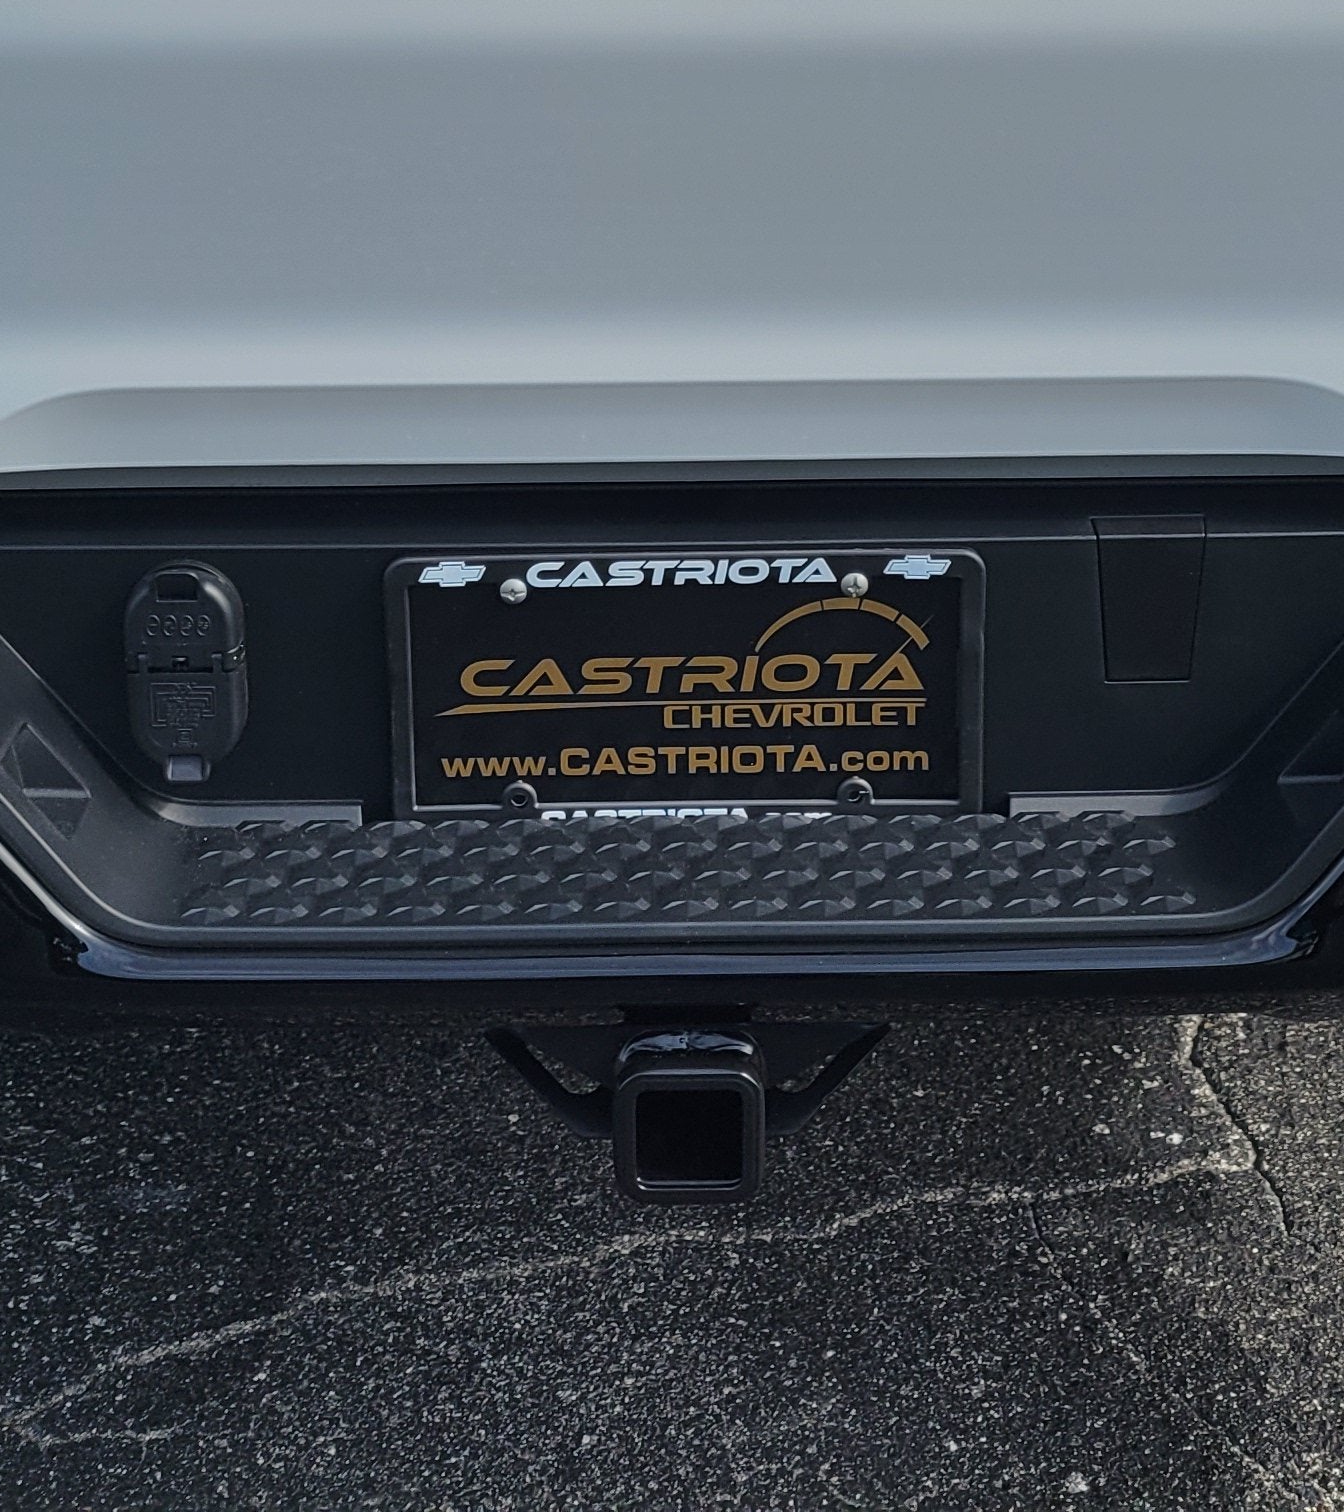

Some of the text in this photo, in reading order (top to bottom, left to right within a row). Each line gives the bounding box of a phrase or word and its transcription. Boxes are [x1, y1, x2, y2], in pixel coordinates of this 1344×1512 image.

[525, 557, 838, 588] CASTRIOTA
[459, 653, 926, 697] CASTRIOTA
[663, 702, 924, 730] CHEVROLET
[441, 744, 930, 778] www.CASTRIOTA.com
